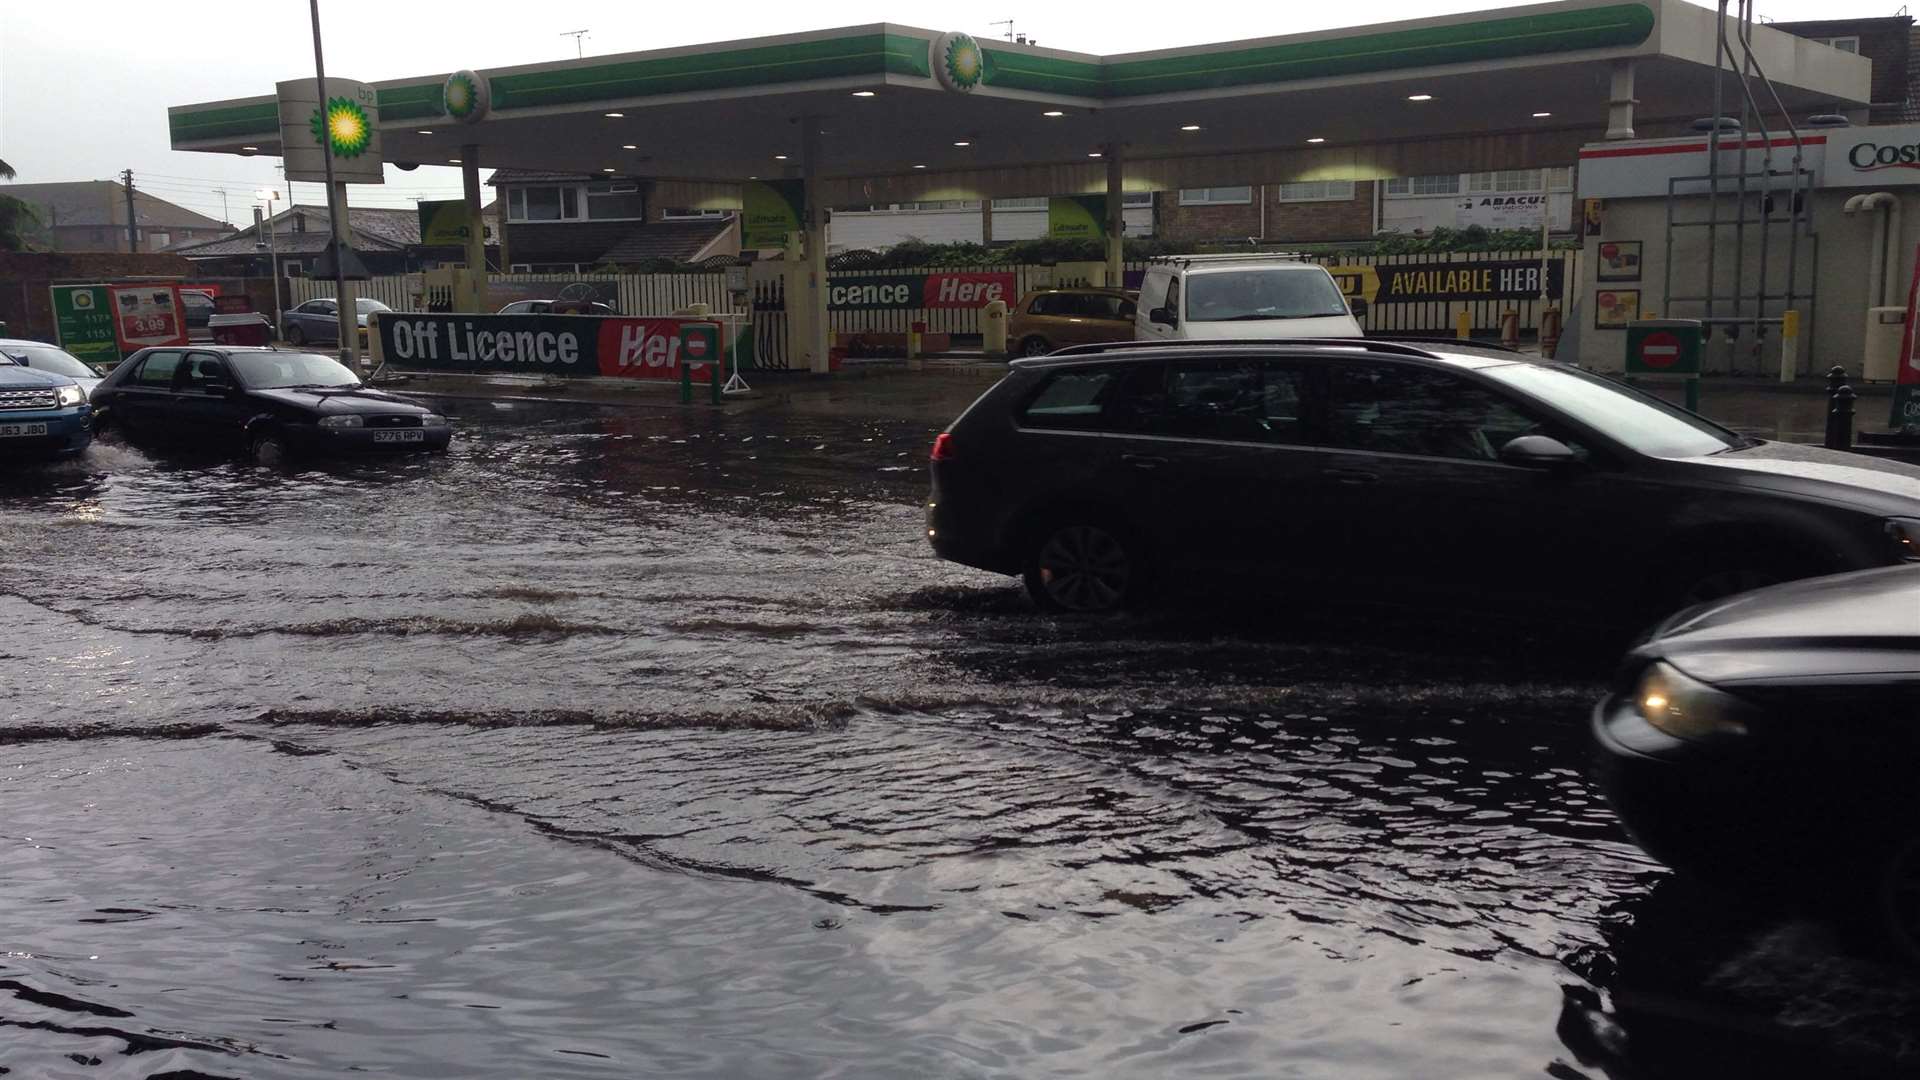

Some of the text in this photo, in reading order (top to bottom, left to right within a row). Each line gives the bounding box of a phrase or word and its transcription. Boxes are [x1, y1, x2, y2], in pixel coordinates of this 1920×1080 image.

[358, 86, 374, 103] bp
[939, 278, 1003, 303] Here
[1391, 268, 1492, 295] AVAILABLE
[393, 320, 706, 370] Off Licence Her
